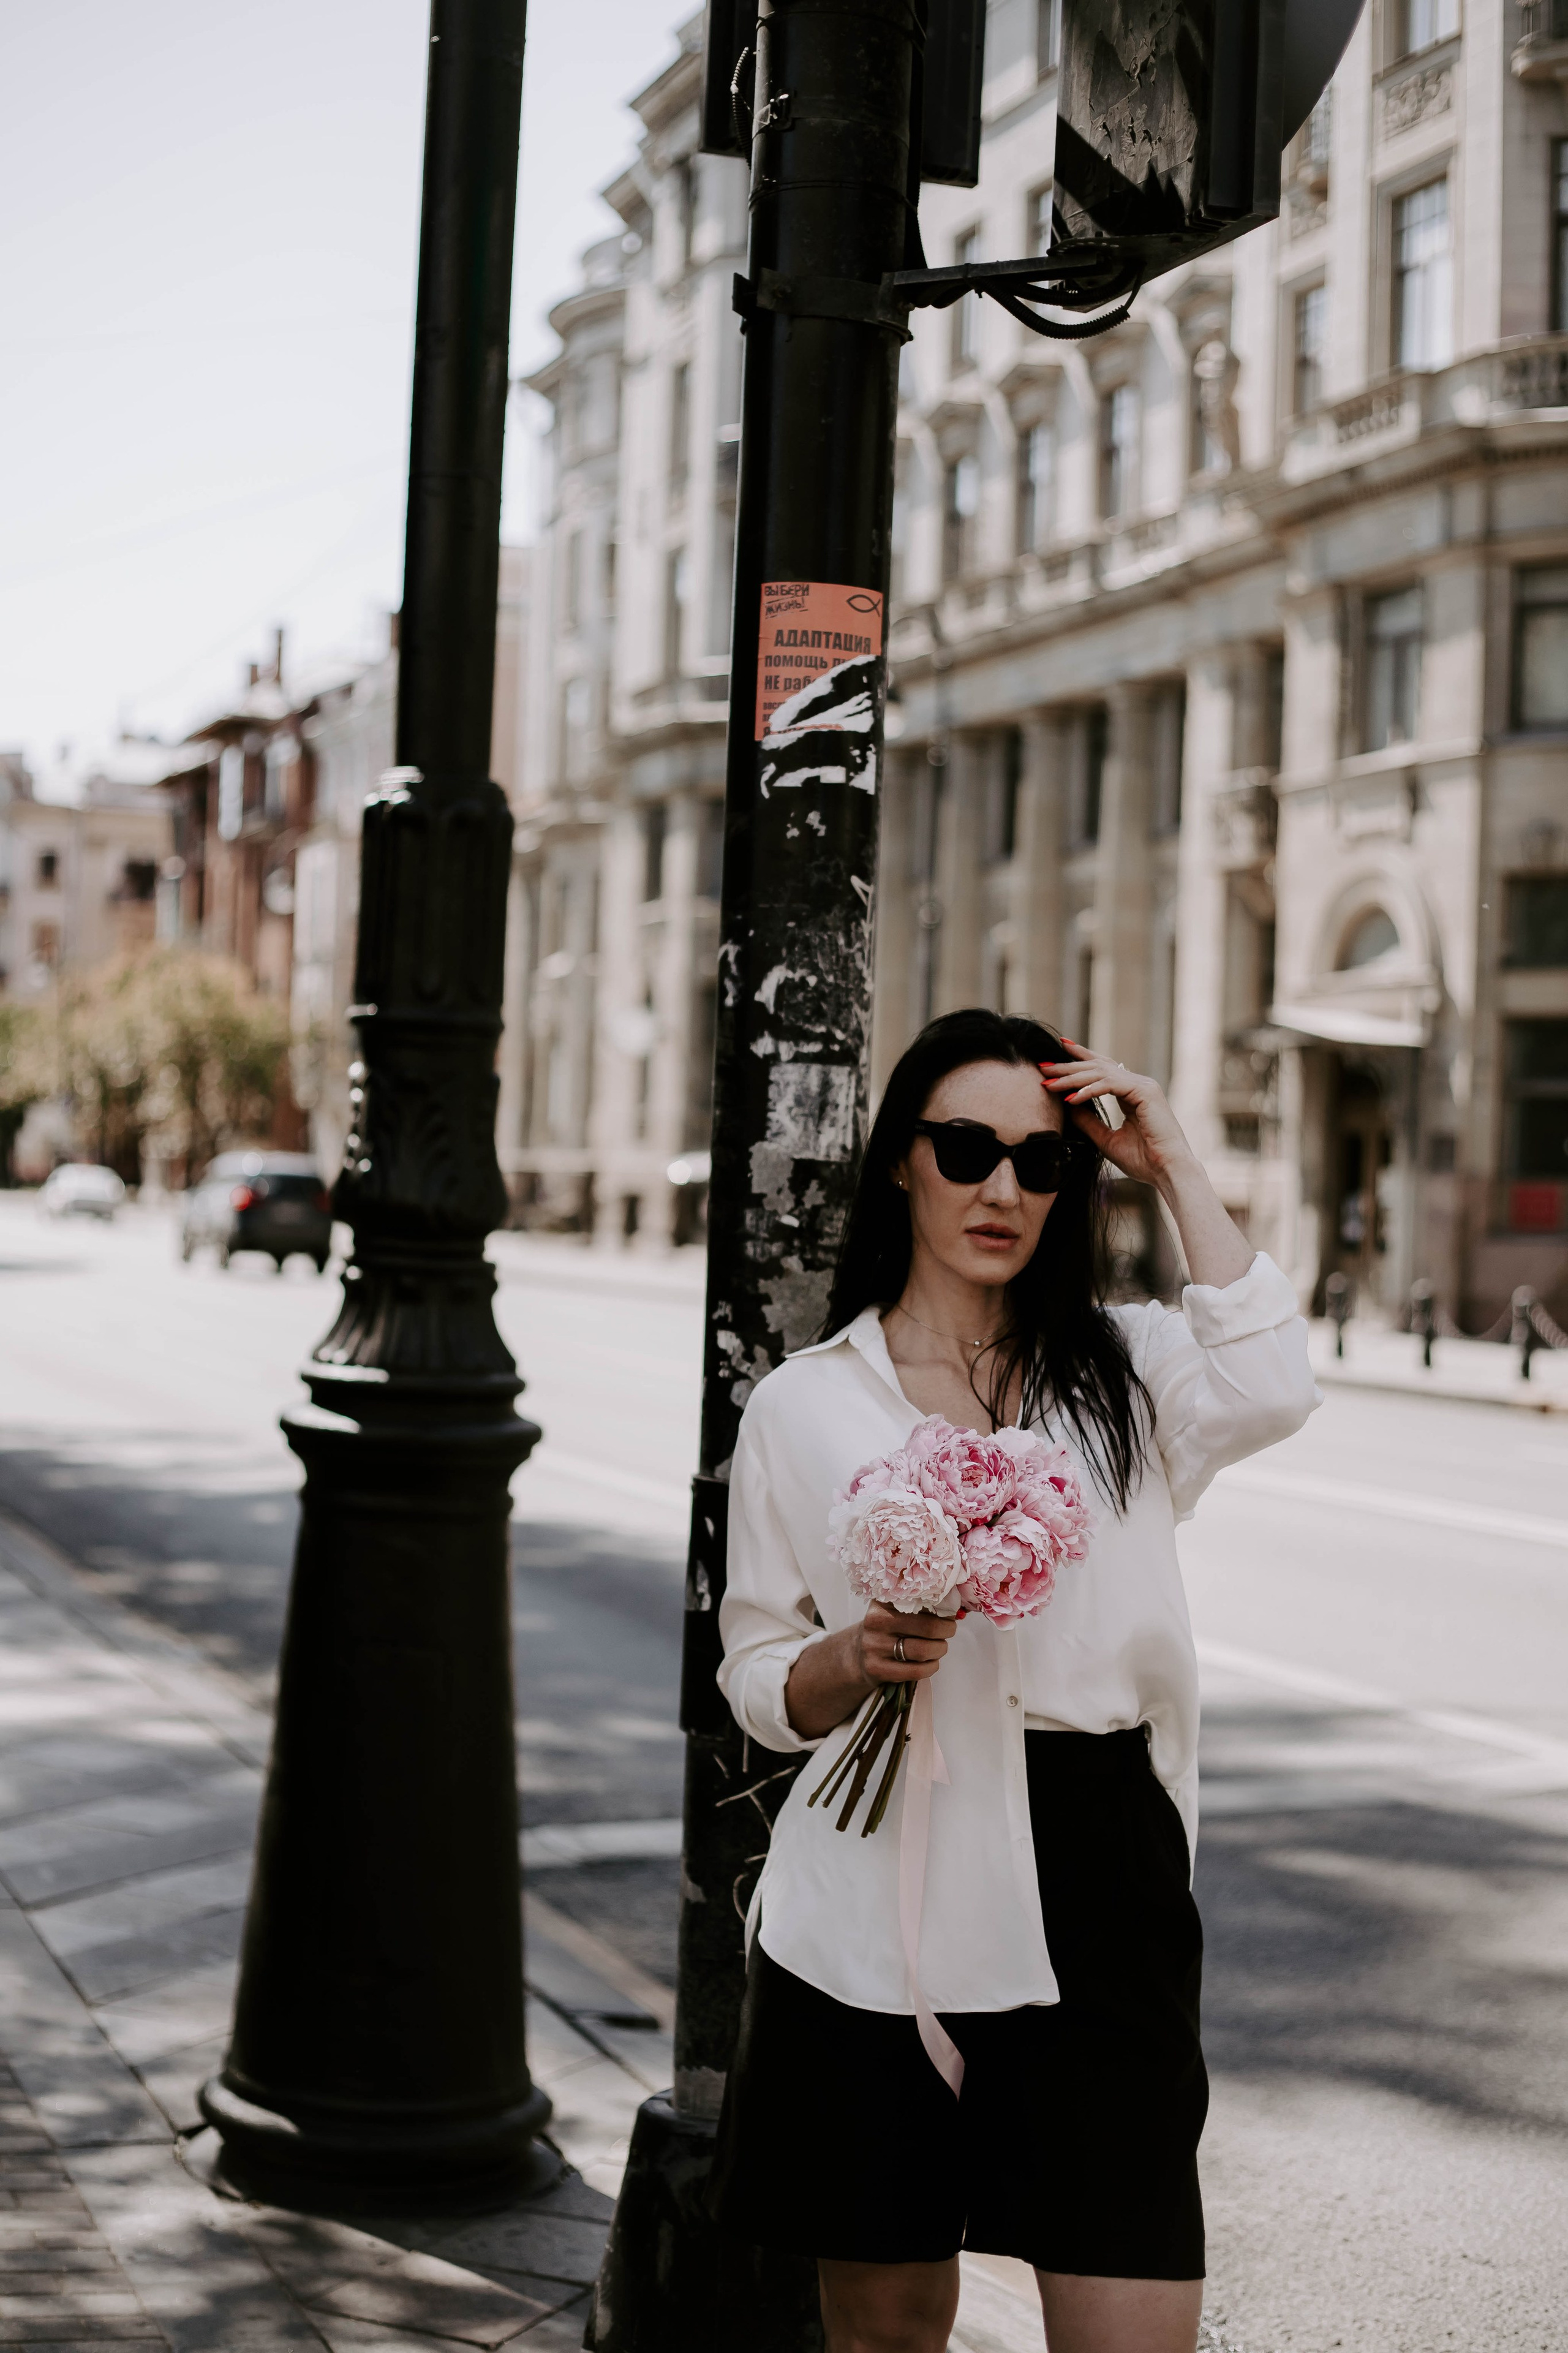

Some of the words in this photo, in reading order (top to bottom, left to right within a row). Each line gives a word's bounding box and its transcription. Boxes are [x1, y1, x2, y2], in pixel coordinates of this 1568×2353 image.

[774, 629, 871, 655] АДАПТАЦИЯ
[764, 655, 827, 670] ПОМОЩЬ
[765, 675, 780, 690] НЕ
[783, 676, 816, 691] раб
